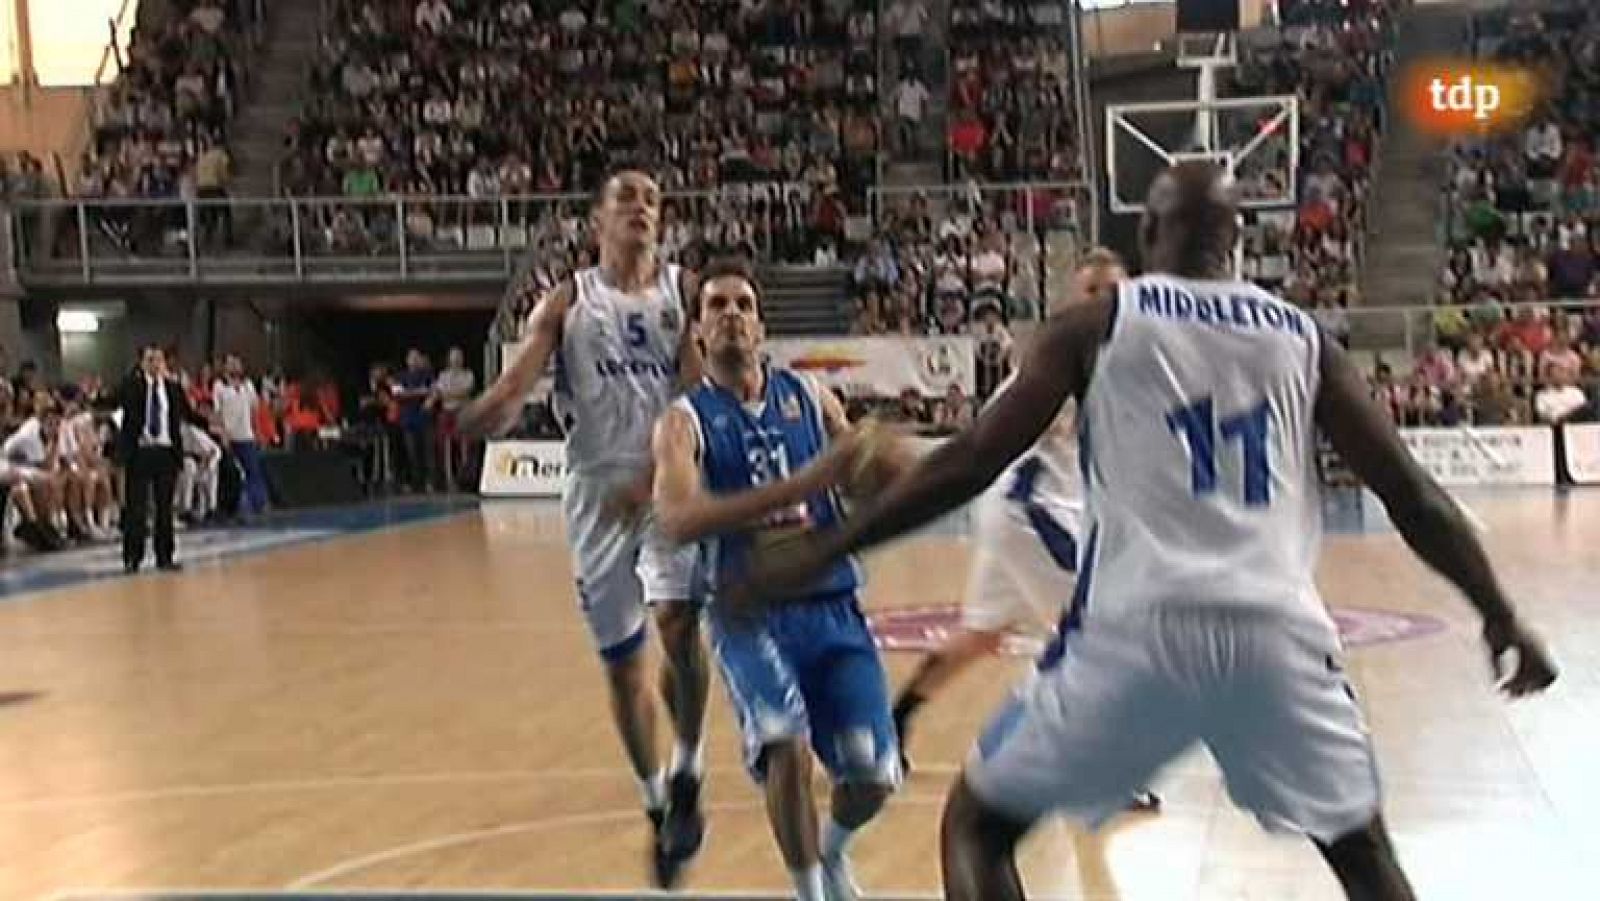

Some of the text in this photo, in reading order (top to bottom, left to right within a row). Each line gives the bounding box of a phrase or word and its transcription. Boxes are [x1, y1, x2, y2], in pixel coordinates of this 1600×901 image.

[627, 313, 646, 347] 5
[1137, 284, 1304, 335] MIDDLETON
[748, 444, 791, 486] 31
[1164, 396, 1270, 507] 11
